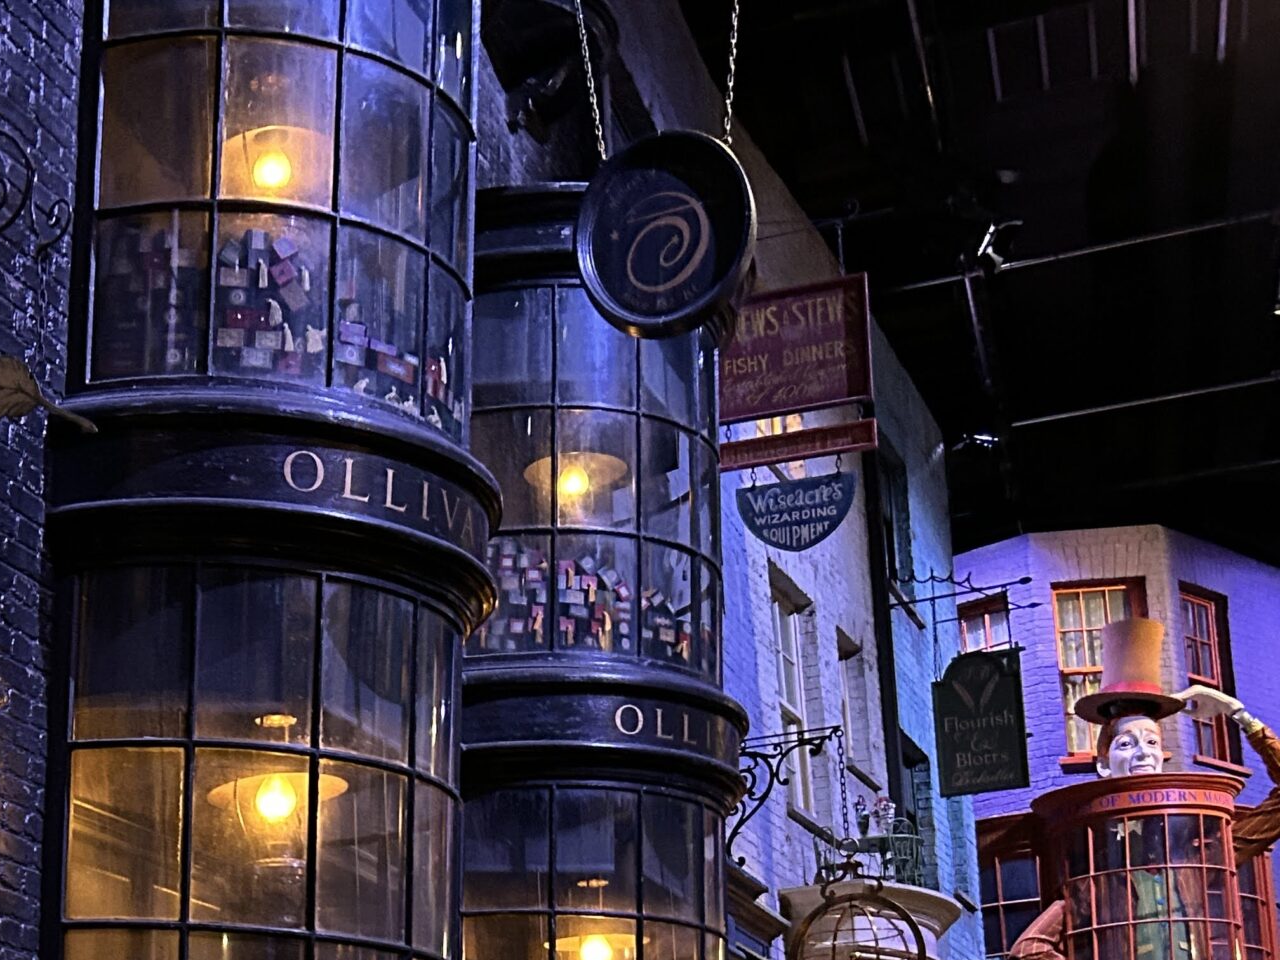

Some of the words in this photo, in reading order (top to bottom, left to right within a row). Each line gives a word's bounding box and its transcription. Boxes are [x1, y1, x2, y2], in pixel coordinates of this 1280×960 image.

[724, 353, 769, 376] FISHY
[782, 340, 856, 368] DINNERS
[745, 482, 843, 514] Wiseacre's
[754, 505, 838, 526] WIZARDING
[762, 521, 831, 547] EQUIPMENT
[943, 709, 1015, 733] Flourish
[1099, 796, 1120, 809] OF
[1128, 790, 1197, 805] MODERN
